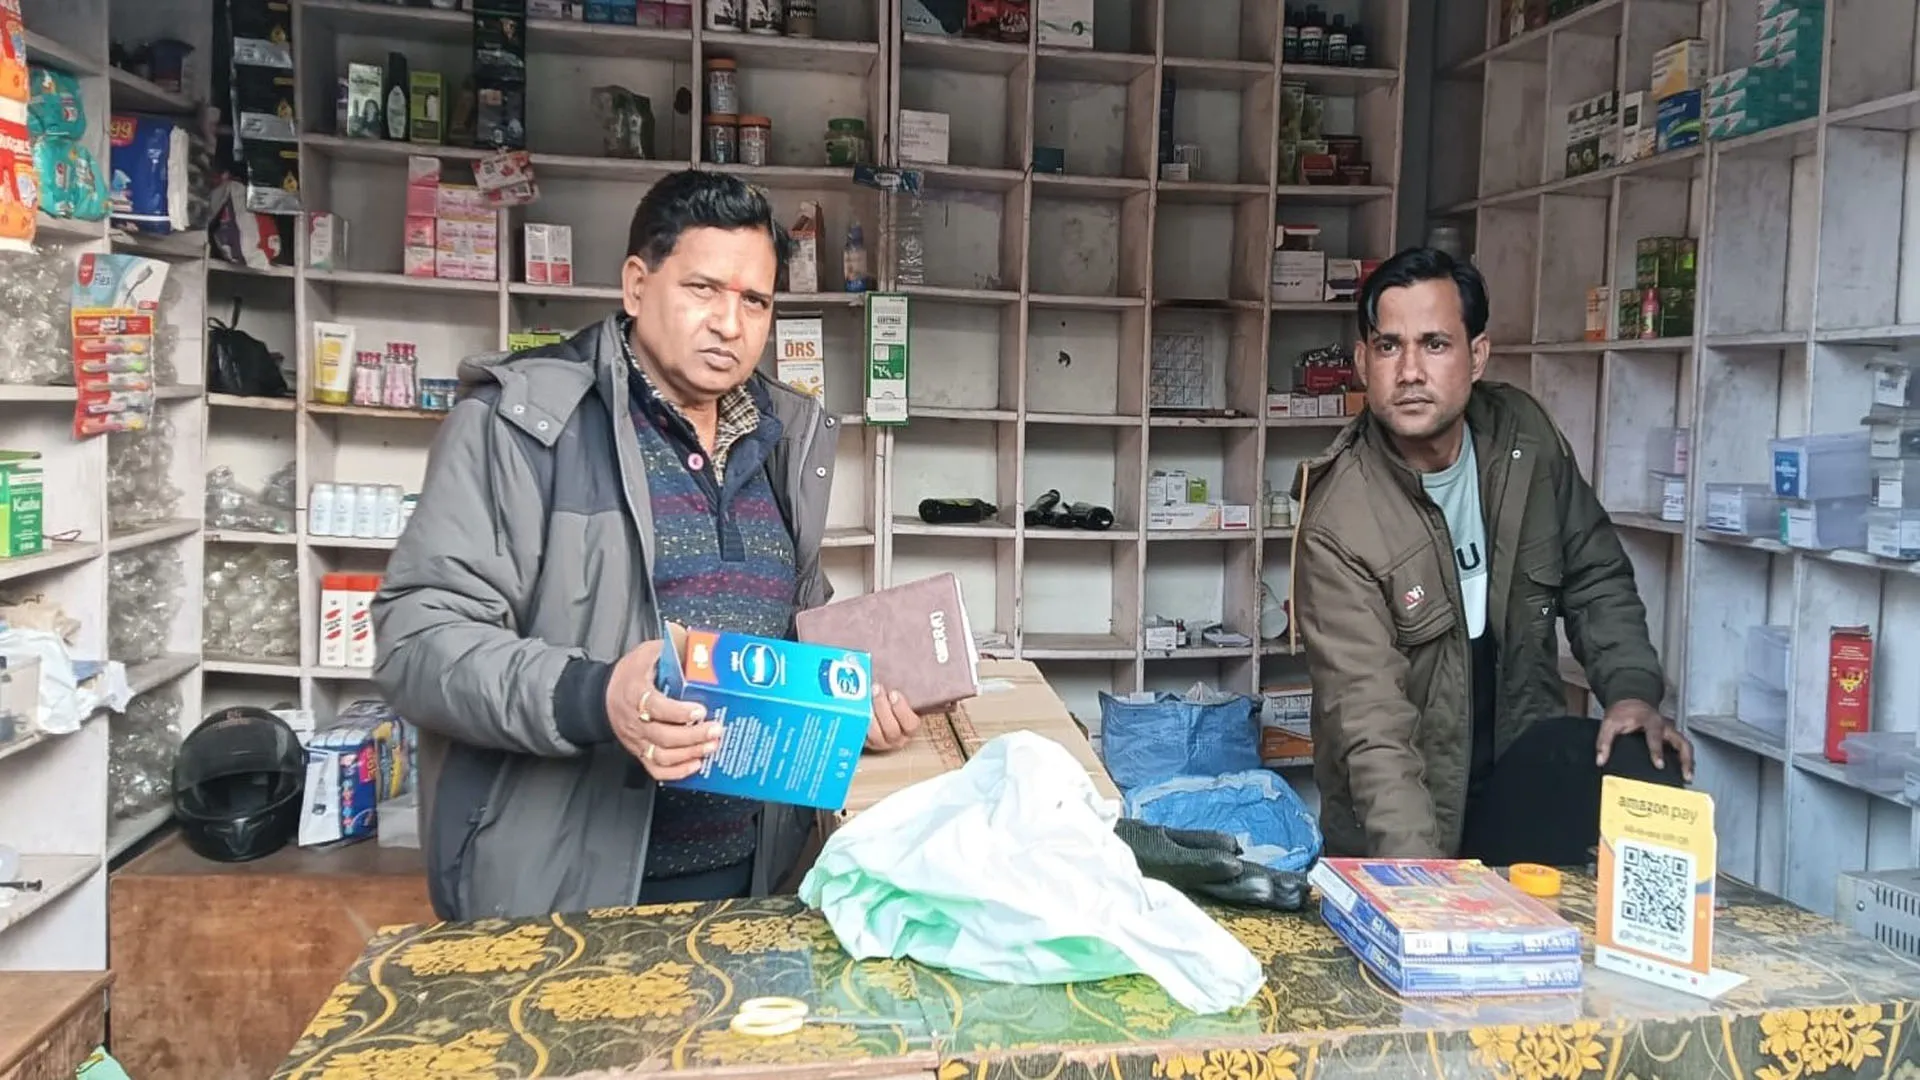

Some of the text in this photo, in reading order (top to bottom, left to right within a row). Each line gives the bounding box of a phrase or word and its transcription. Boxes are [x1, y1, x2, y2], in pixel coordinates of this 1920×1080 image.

[785, 341, 815, 357] ORS
[1456, 542, 1481, 570] U
[1618, 796, 1698, 825] amazon pay
